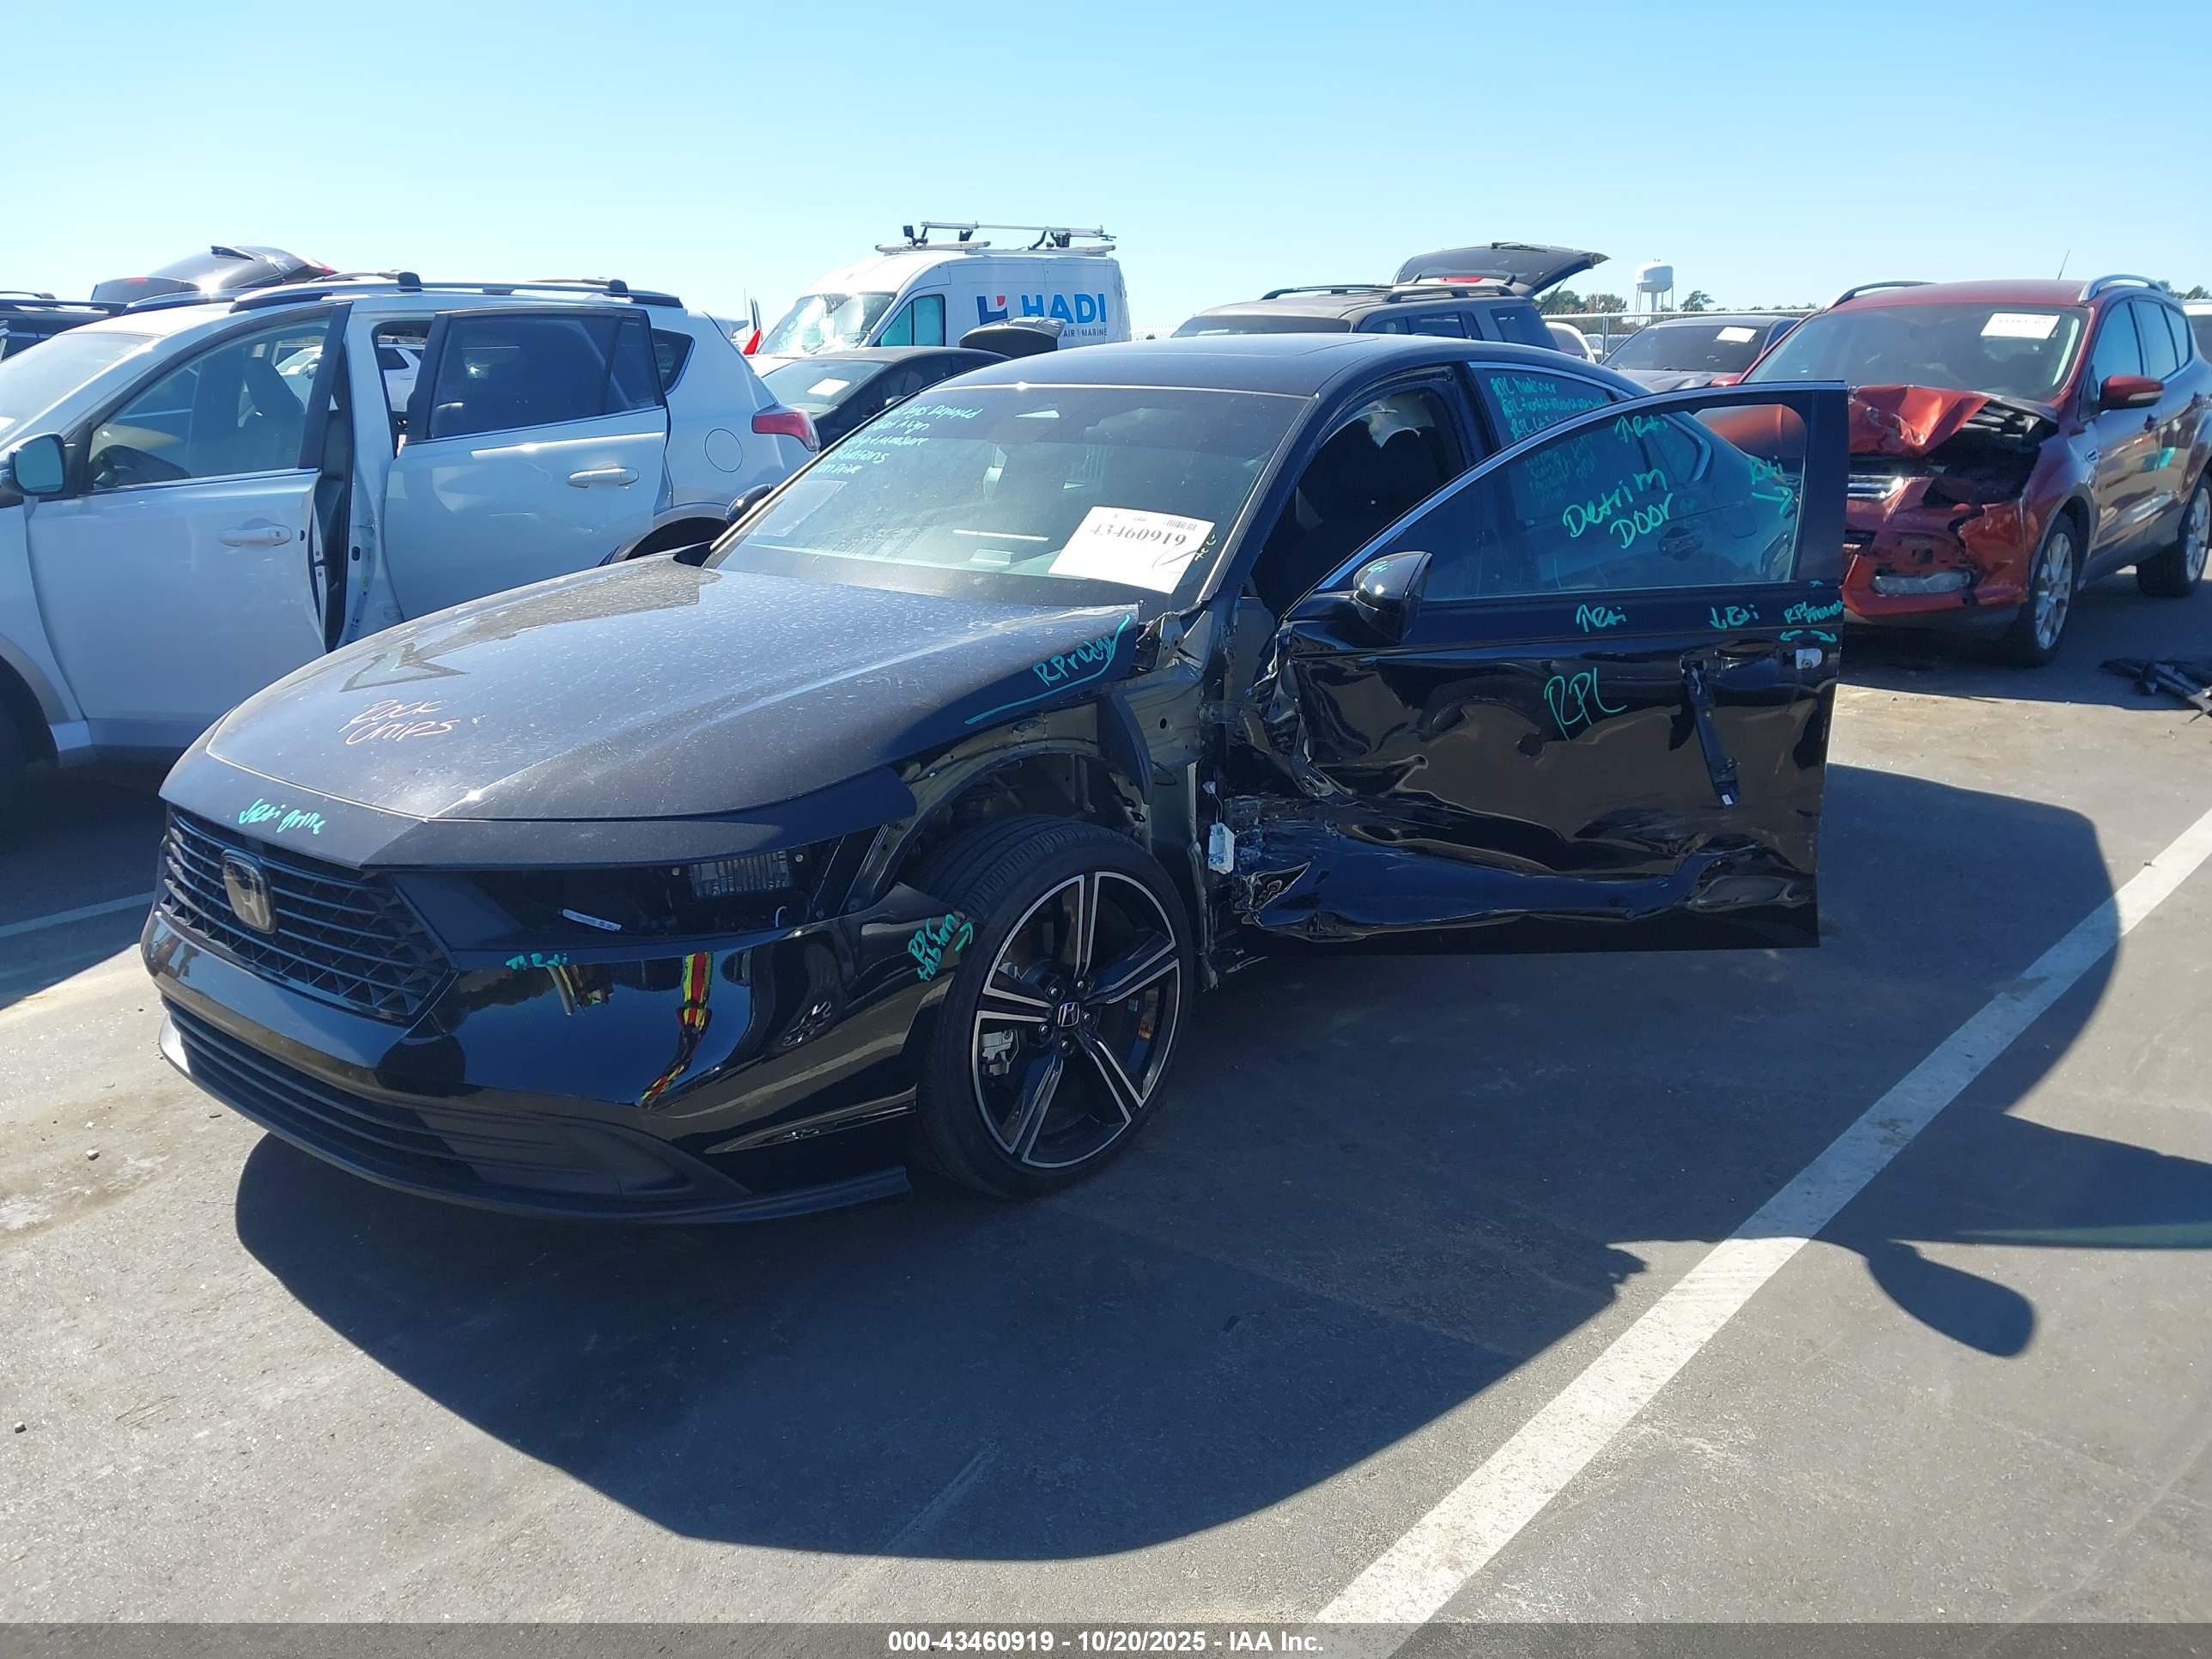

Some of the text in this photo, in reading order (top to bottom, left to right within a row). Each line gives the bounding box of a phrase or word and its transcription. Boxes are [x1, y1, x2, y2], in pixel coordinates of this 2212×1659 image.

[1020, 293, 1107, 324] HADI
[1063, 328, 1108, 337] AIR MARINE
[1090, 522, 1188, 548] 43460919
